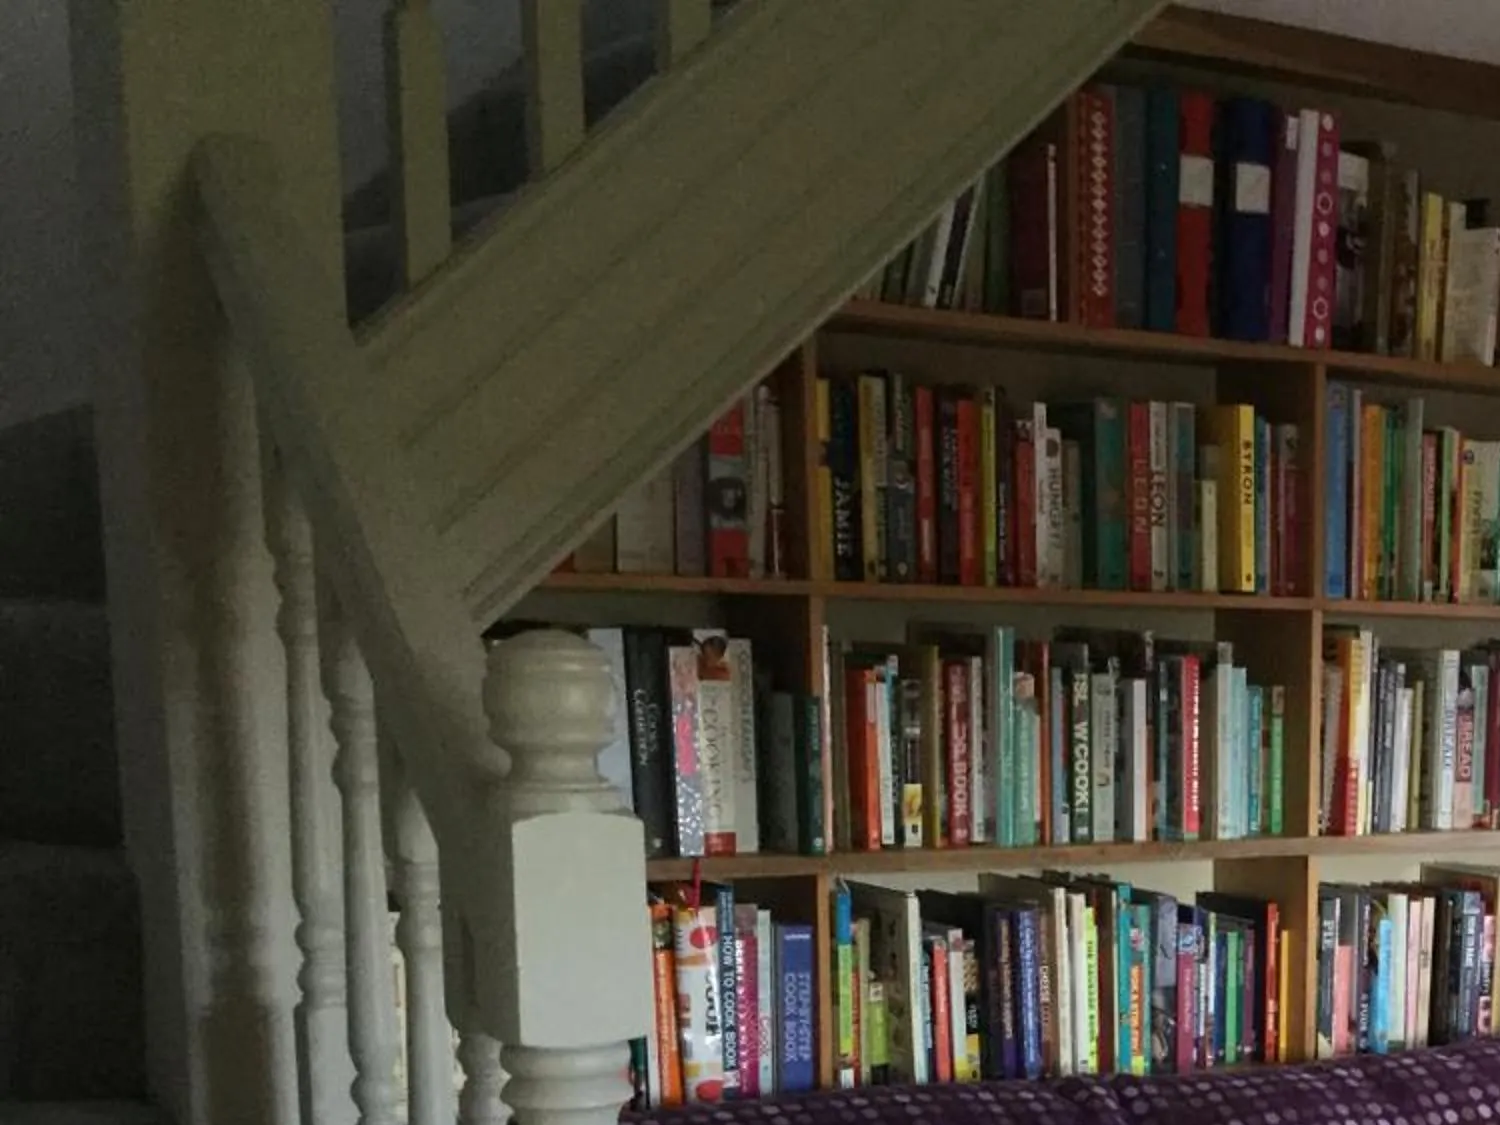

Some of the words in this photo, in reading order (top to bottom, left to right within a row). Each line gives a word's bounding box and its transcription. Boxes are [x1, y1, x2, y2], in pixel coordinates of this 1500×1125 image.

[835, 476, 853, 557] JAMIE
[1133, 458, 1148, 534] LEON
[1151, 470, 1168, 528] LEON
[722, 935, 734, 966] HOW
[723, 971, 734, 988] TO
[784, 971, 797, 1016] COOK
[724, 990, 735, 1027] COOK
[726, 1031, 737, 1069] BOOK
[784, 1020, 797, 1063] BOOK
